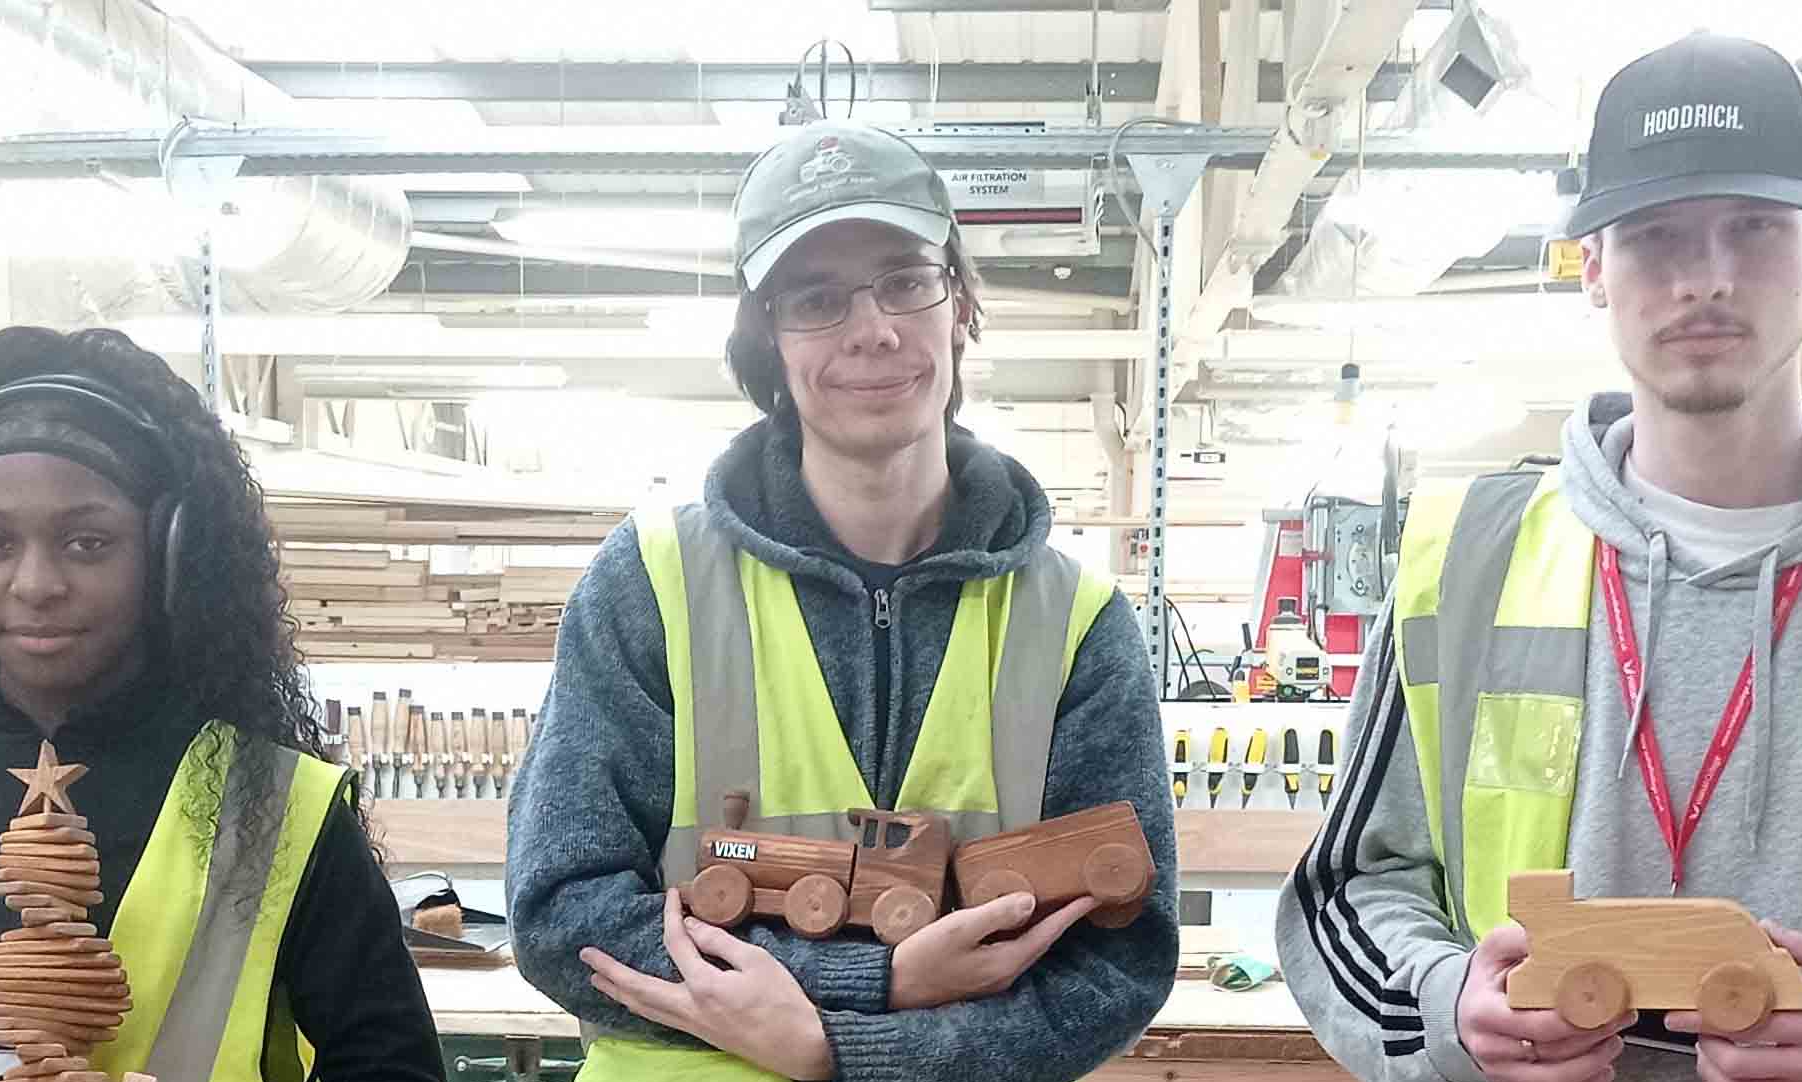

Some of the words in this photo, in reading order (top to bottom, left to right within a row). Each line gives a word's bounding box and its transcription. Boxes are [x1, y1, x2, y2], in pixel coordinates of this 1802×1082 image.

[951, 173, 967, 181] AIR
[971, 173, 1027, 182] FILTRATION
[969, 185, 1009, 194] SYSTEM
[715, 842, 755, 860] VIXEN
